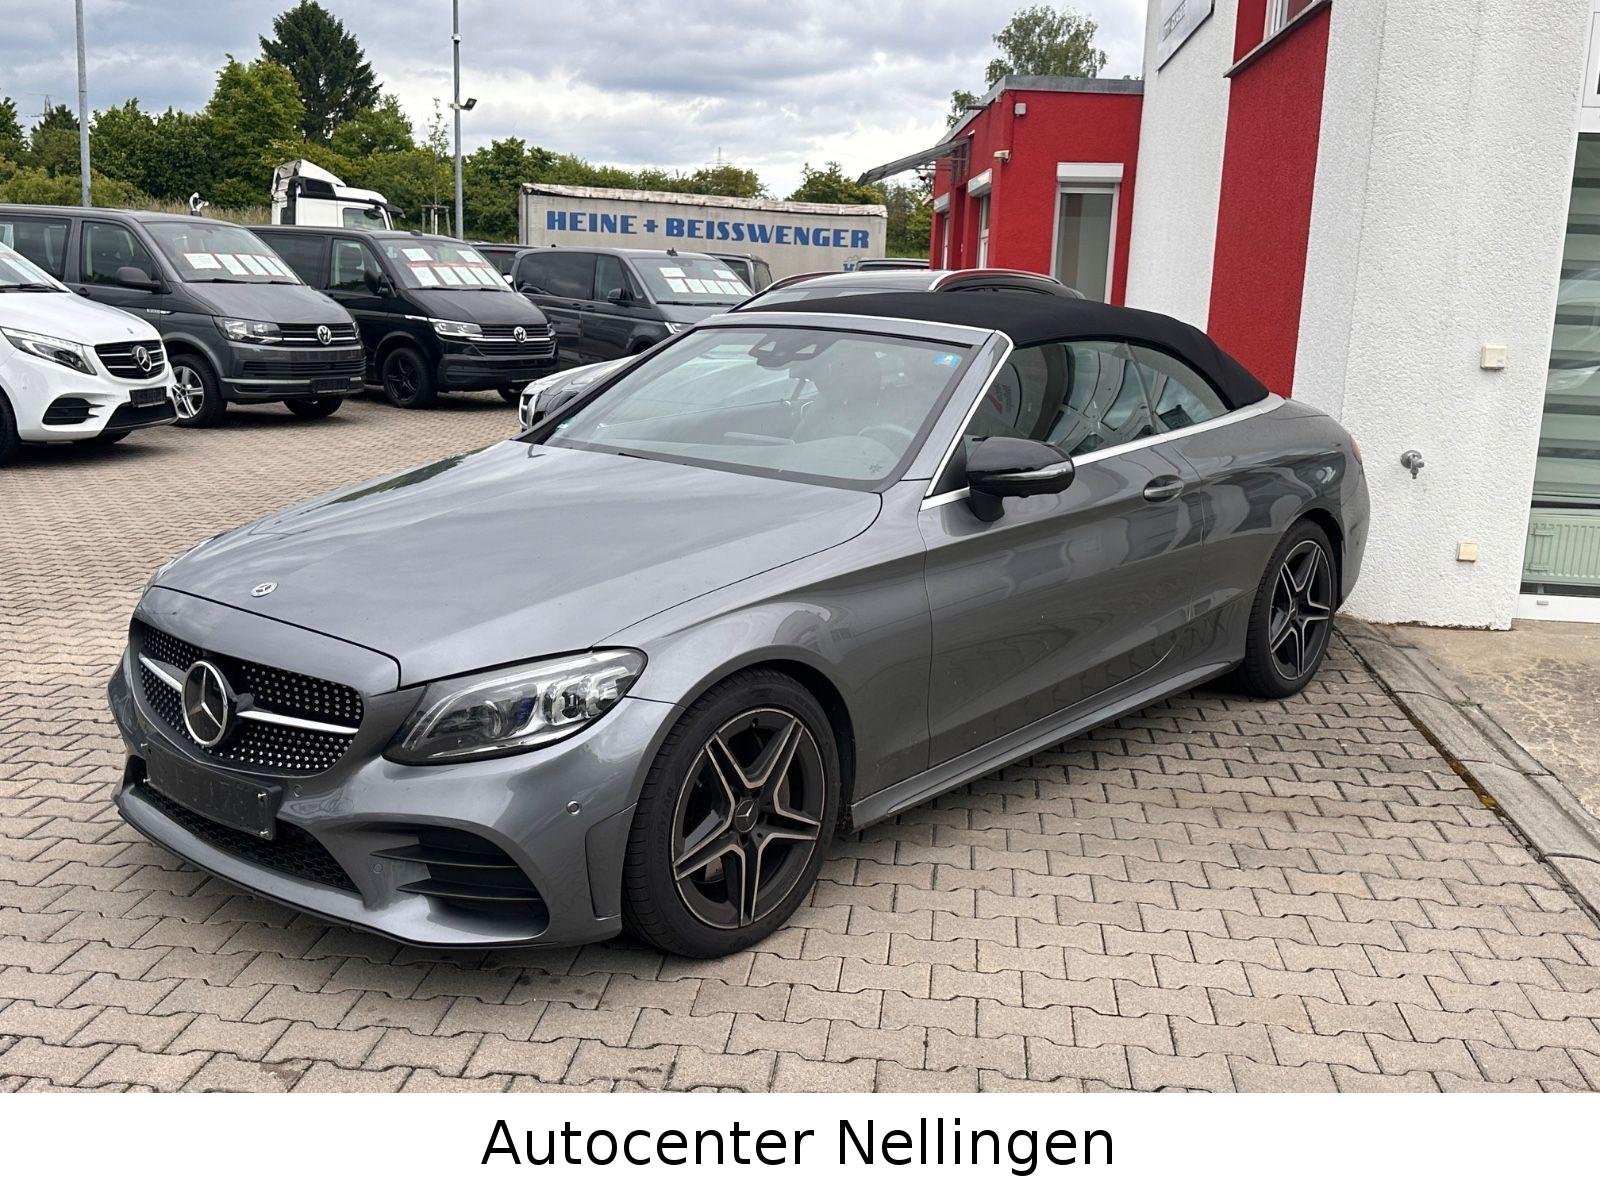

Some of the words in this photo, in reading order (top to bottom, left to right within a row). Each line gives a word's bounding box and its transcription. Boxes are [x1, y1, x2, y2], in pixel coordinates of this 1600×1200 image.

[546, 210, 638, 235] HEINE
[643, 218, 658, 234] +
[664, 217, 870, 250] BEISSWENGER
